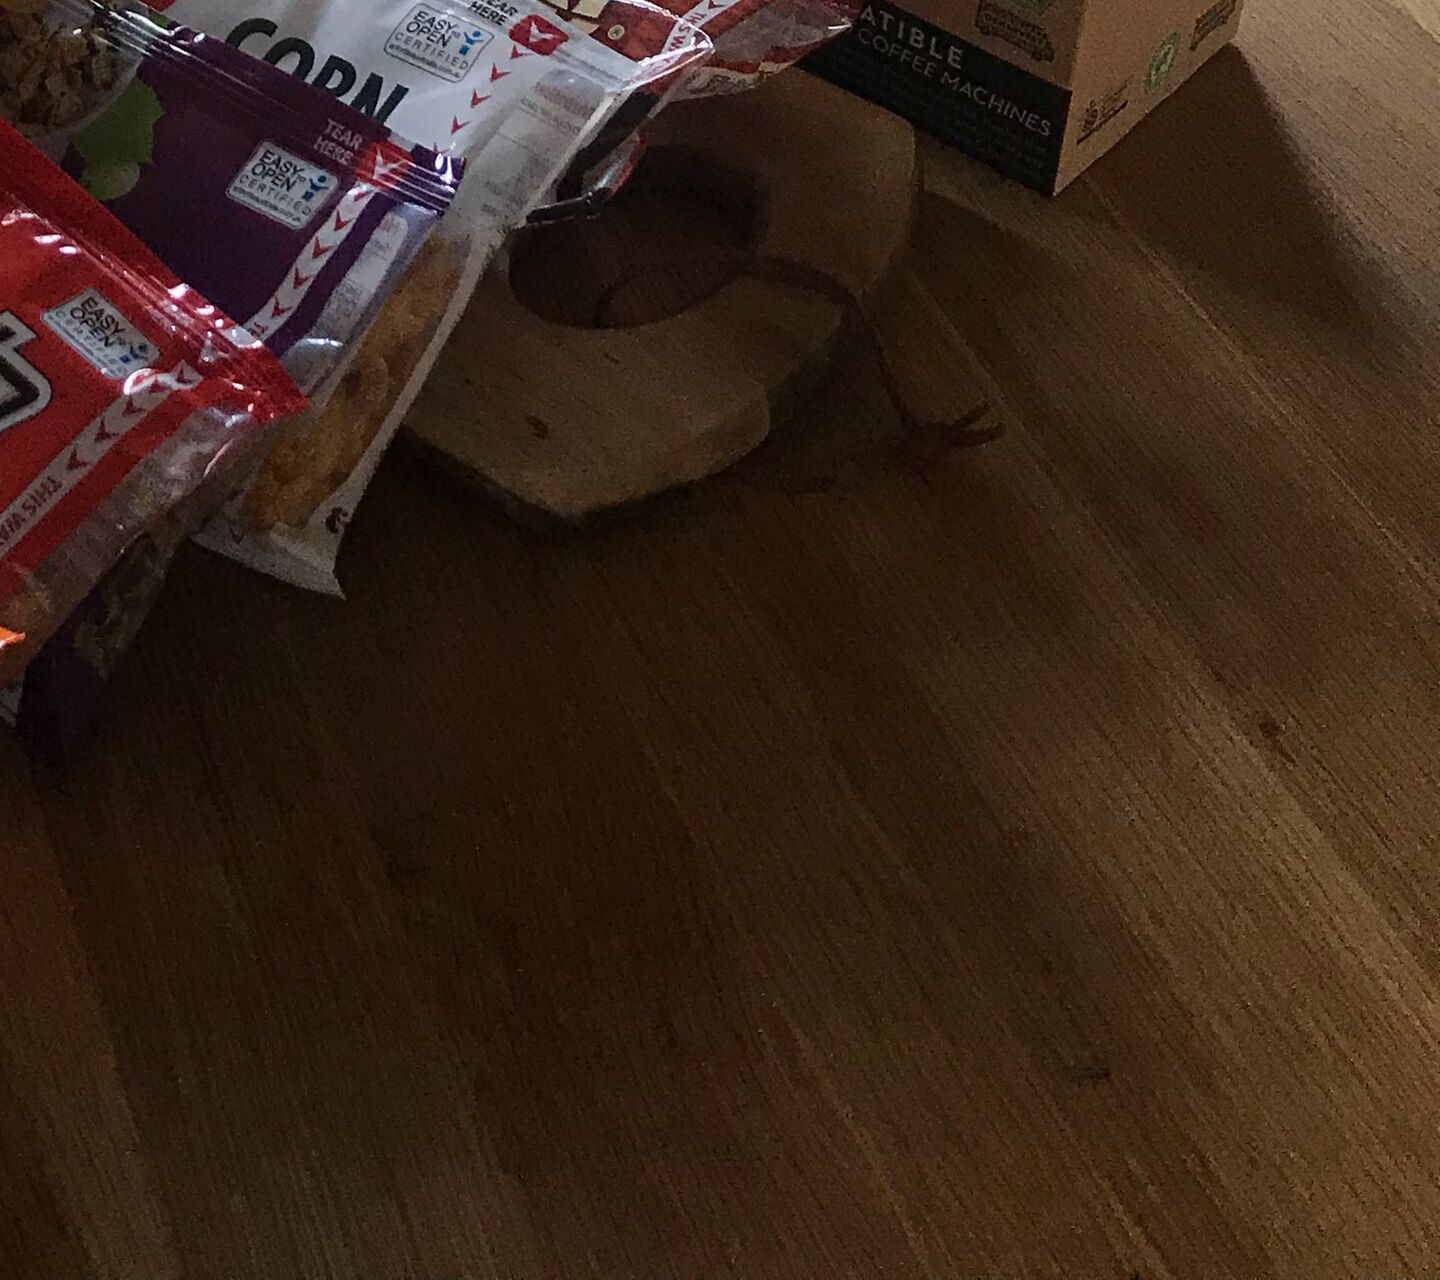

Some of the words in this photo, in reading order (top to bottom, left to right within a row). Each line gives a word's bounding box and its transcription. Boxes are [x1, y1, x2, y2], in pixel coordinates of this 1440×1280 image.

[414, 9, 460, 35] EASY
[468, 1, 509, 27] HERE
[394, 32, 469, 70] CERTIFIED
[406, 21, 453, 48] OPEN
[858, 28, 938, 79] COFFEE
[940, 71, 1052, 137] MACHINES
[252, 162, 298, 191] OPEN
[260, 149, 305, 178] EASY
[70, 307, 117, 347] OPEN
[81, 296, 126, 336] EASY
[21, 475, 62, 516] THIS
